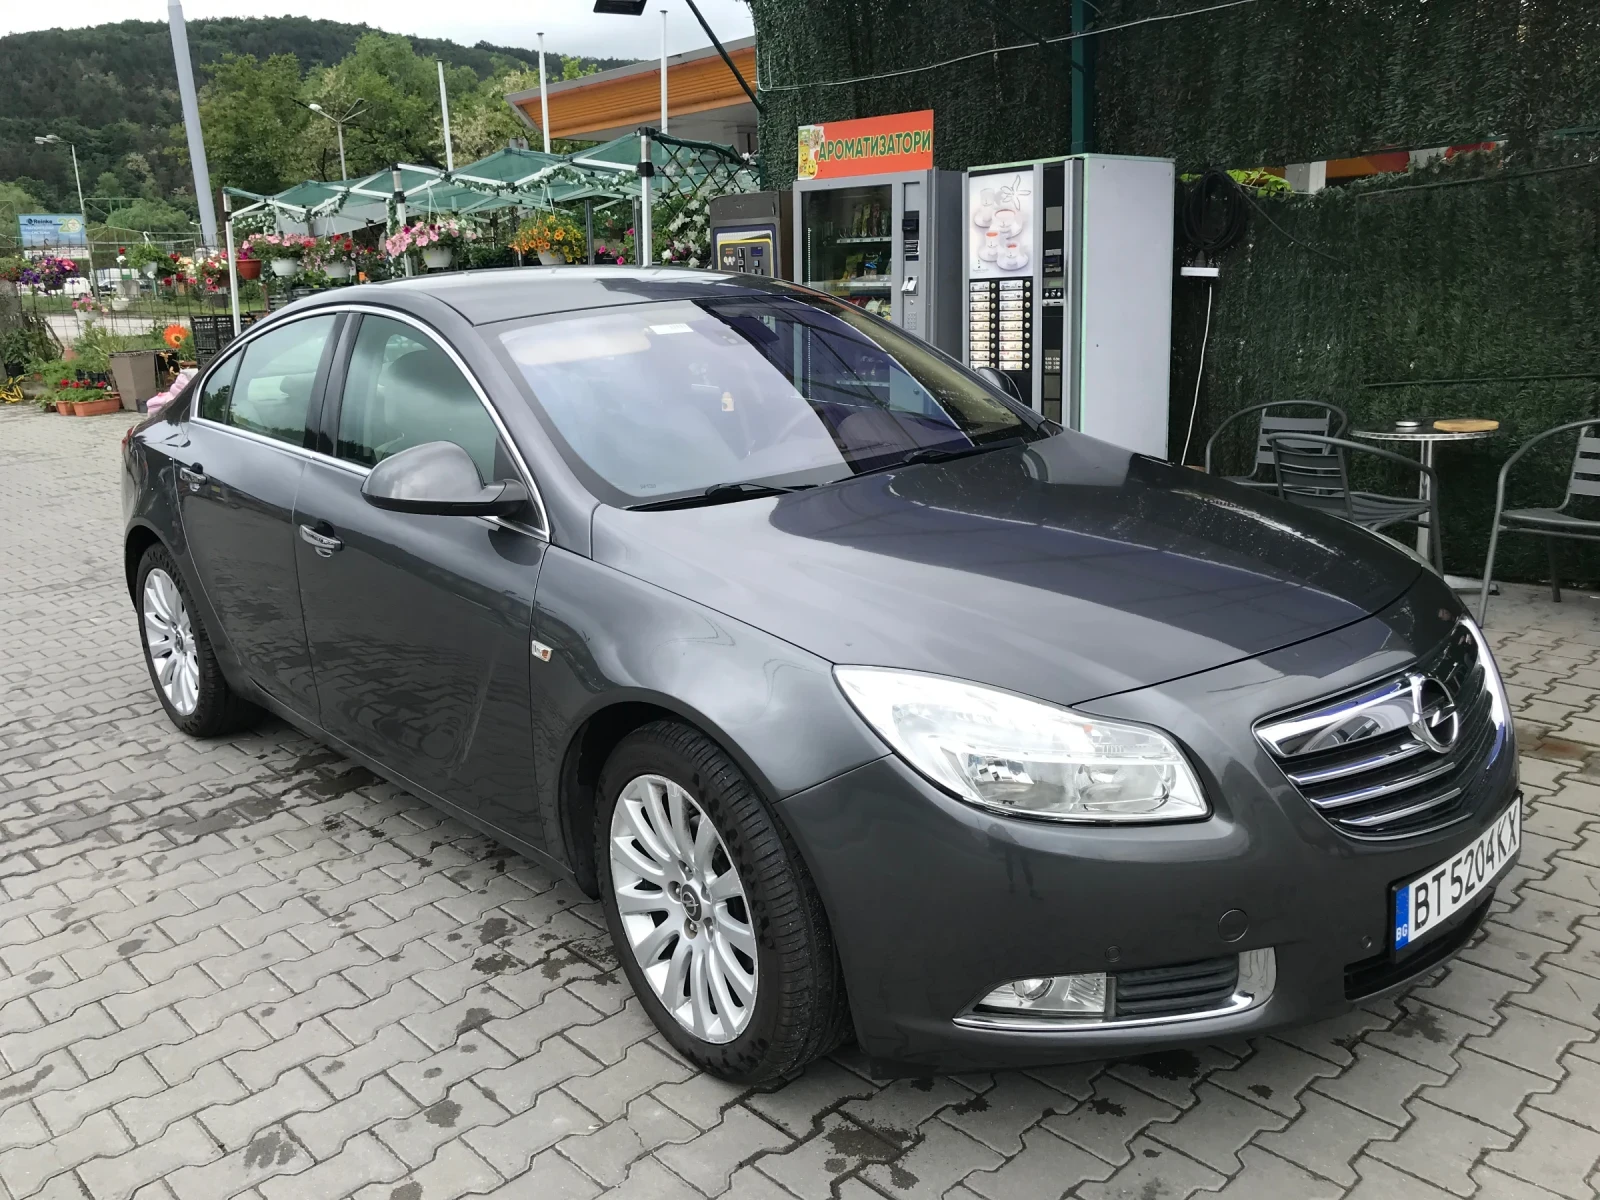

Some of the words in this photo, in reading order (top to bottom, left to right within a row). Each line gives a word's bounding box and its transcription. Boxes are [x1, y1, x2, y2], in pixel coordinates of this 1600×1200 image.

[818, 129, 932, 162] АРОМАТИЗАТОРИ
[58, 218, 82, 233] 20
[1396, 924, 1408, 942] BG
